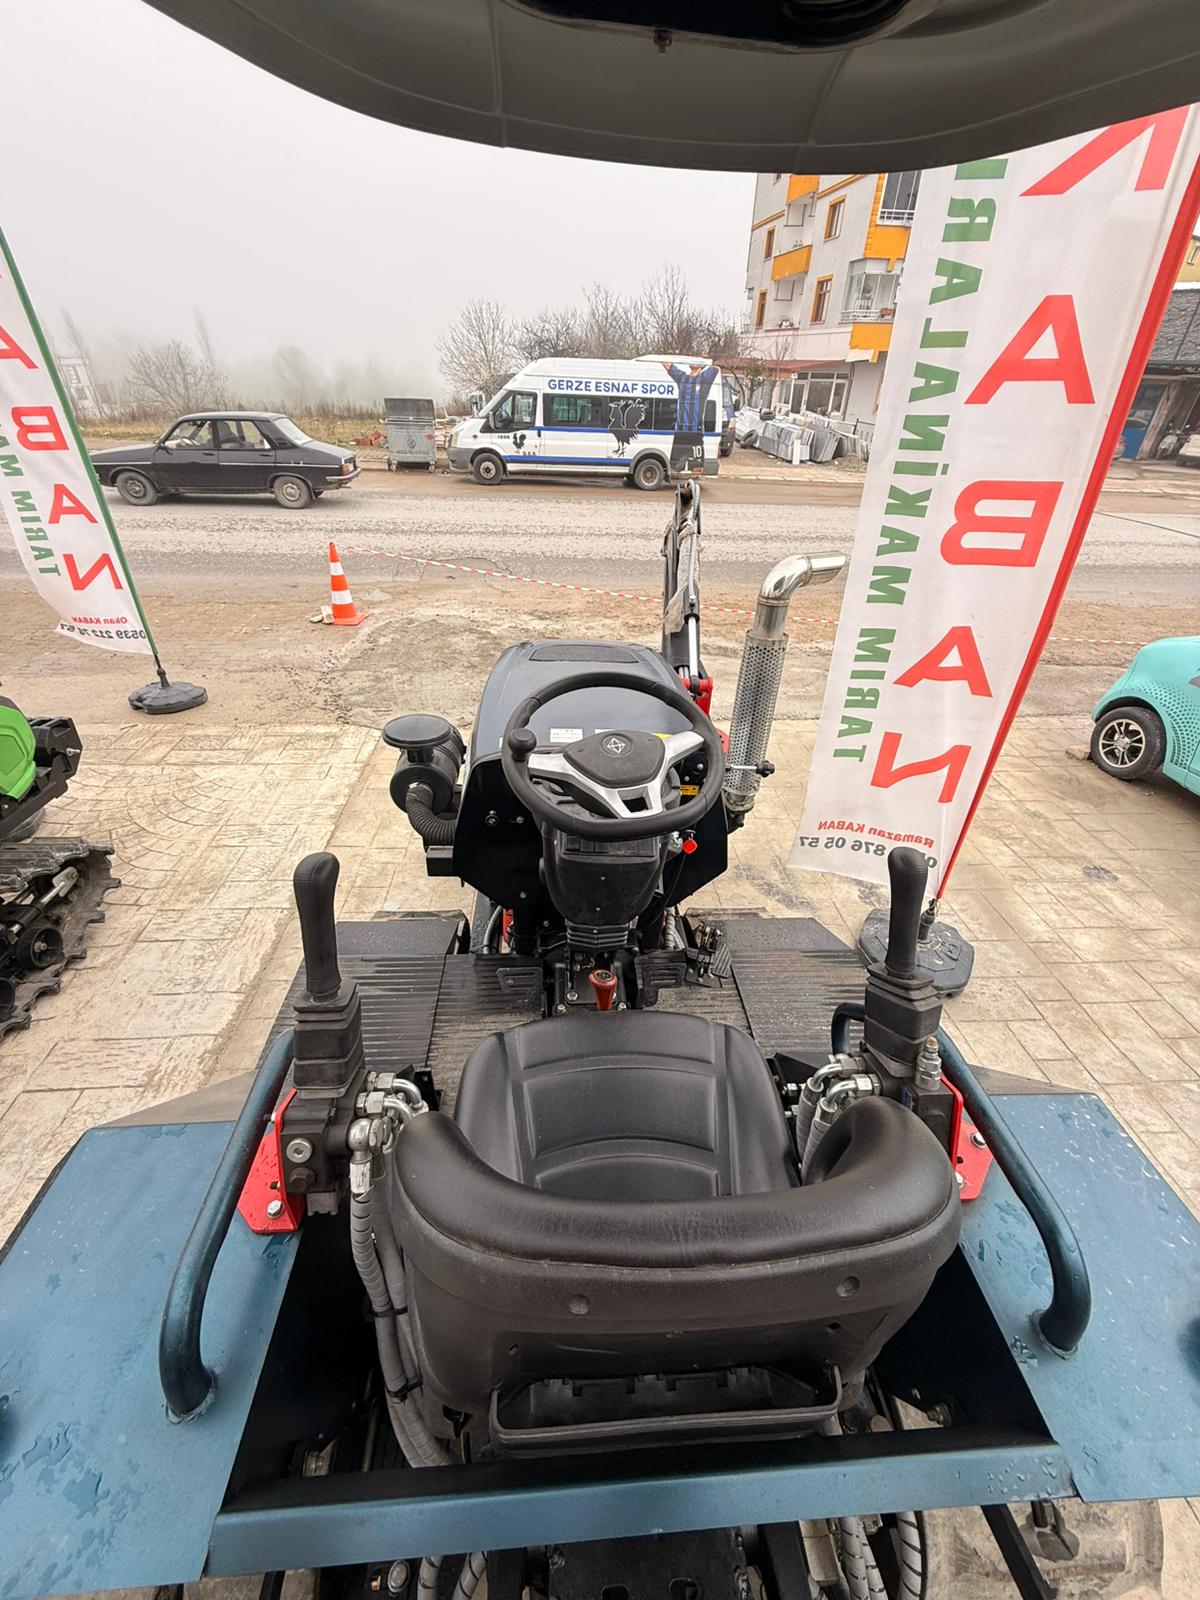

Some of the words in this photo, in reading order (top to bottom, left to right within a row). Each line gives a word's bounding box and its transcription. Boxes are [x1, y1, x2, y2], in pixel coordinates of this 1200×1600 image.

[548, 379, 592, 392] GERZE
[595, 381, 638, 394] ESNAF
[641, 383, 675, 395] SPOR
[692, 445, 703, 458] 10
